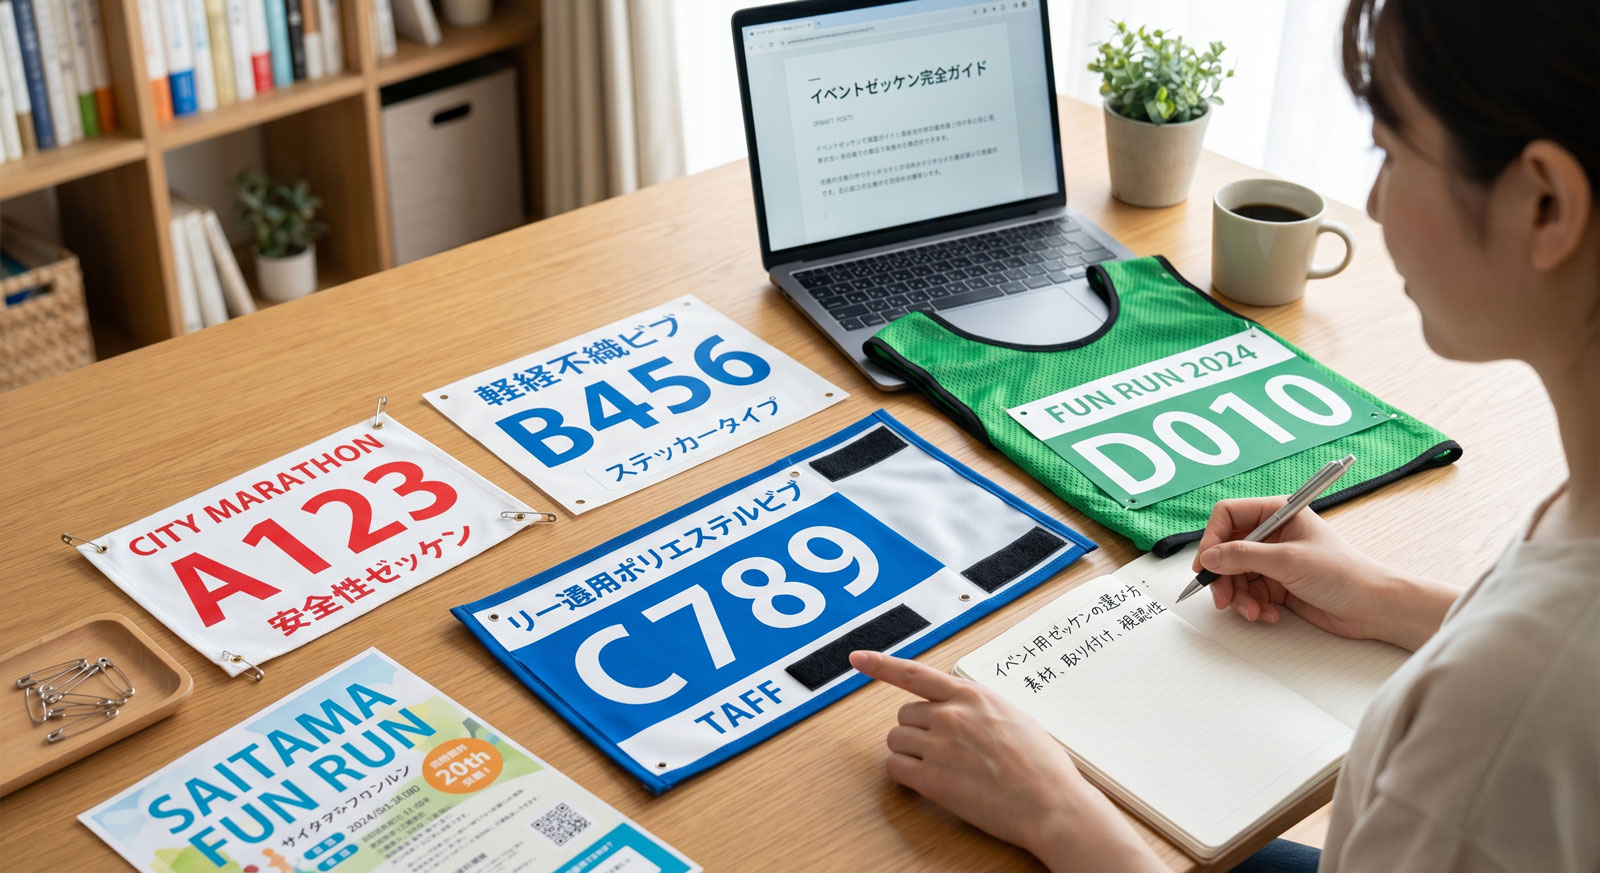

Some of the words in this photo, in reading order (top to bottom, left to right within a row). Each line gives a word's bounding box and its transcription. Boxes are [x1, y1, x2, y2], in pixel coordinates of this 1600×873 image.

[810, 60, 988, 105] イベントゼッケン完全ガイド
[473, 313, 679, 407] 軽経不織ビブ
[495, 334, 771, 468] B456
[1044, 389, 1116, 424] FUN
[1111, 367, 1185, 400] RUN
[1180, 343, 1258, 379] 2024
[605, 396, 780, 482] ステッカータイプ
[1071, 374, 1353, 496] D010
[129, 514, 200, 556] CITY
[203, 433, 385, 524] MARATHON
[170, 460, 458, 628] A123
[267, 525, 471, 637] 安全性ゼッケン
[574, 525, 879, 705] C789
[1023, 600, 1167, 693] 素材、取り付け、視認性
[148, 682, 397, 835] SAITAMA
[694, 679, 783, 736] TAFF
[188, 779, 320, 868] FUN
[308, 707, 437, 793] RUN
[435, 751, 492, 786] 20th
